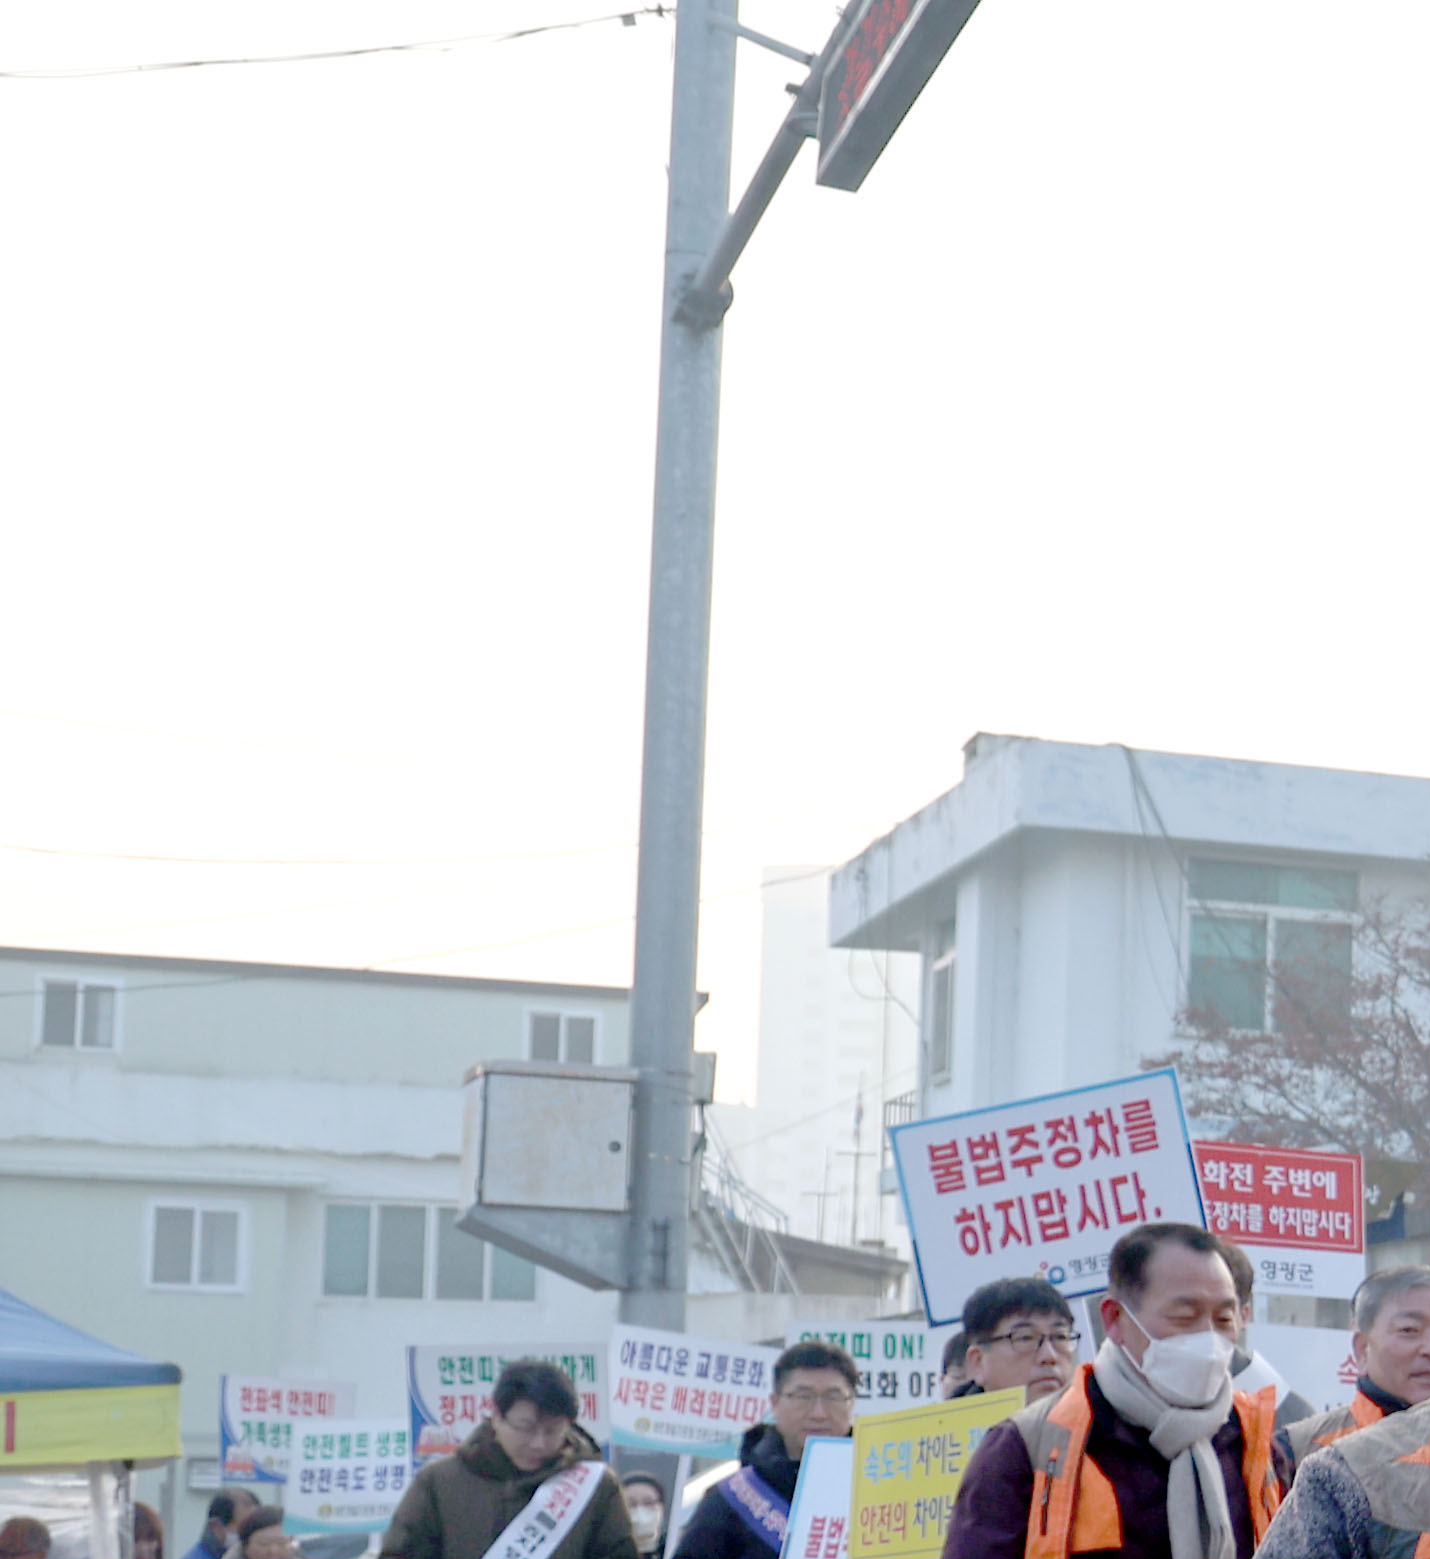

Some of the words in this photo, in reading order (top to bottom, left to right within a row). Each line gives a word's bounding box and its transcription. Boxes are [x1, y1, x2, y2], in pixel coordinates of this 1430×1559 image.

[927, 1098, 1160, 1195] 불법주정차를
[1262, 1164, 1338, 1200] 주변에
[953, 1171, 1163, 1257] 하지맙시다.
[1268, 1205, 1352, 1240] 하지맙시다
[620, 1340, 689, 1376] 아름다운
[883, 1332, 924, 1360] ON!
[614, 1377, 667, 1411] 시작은
[864, 1438, 913, 1485] 속도의
[916, 1432, 962, 1476] 차이는
[860, 1501, 908, 1547] 안전의
